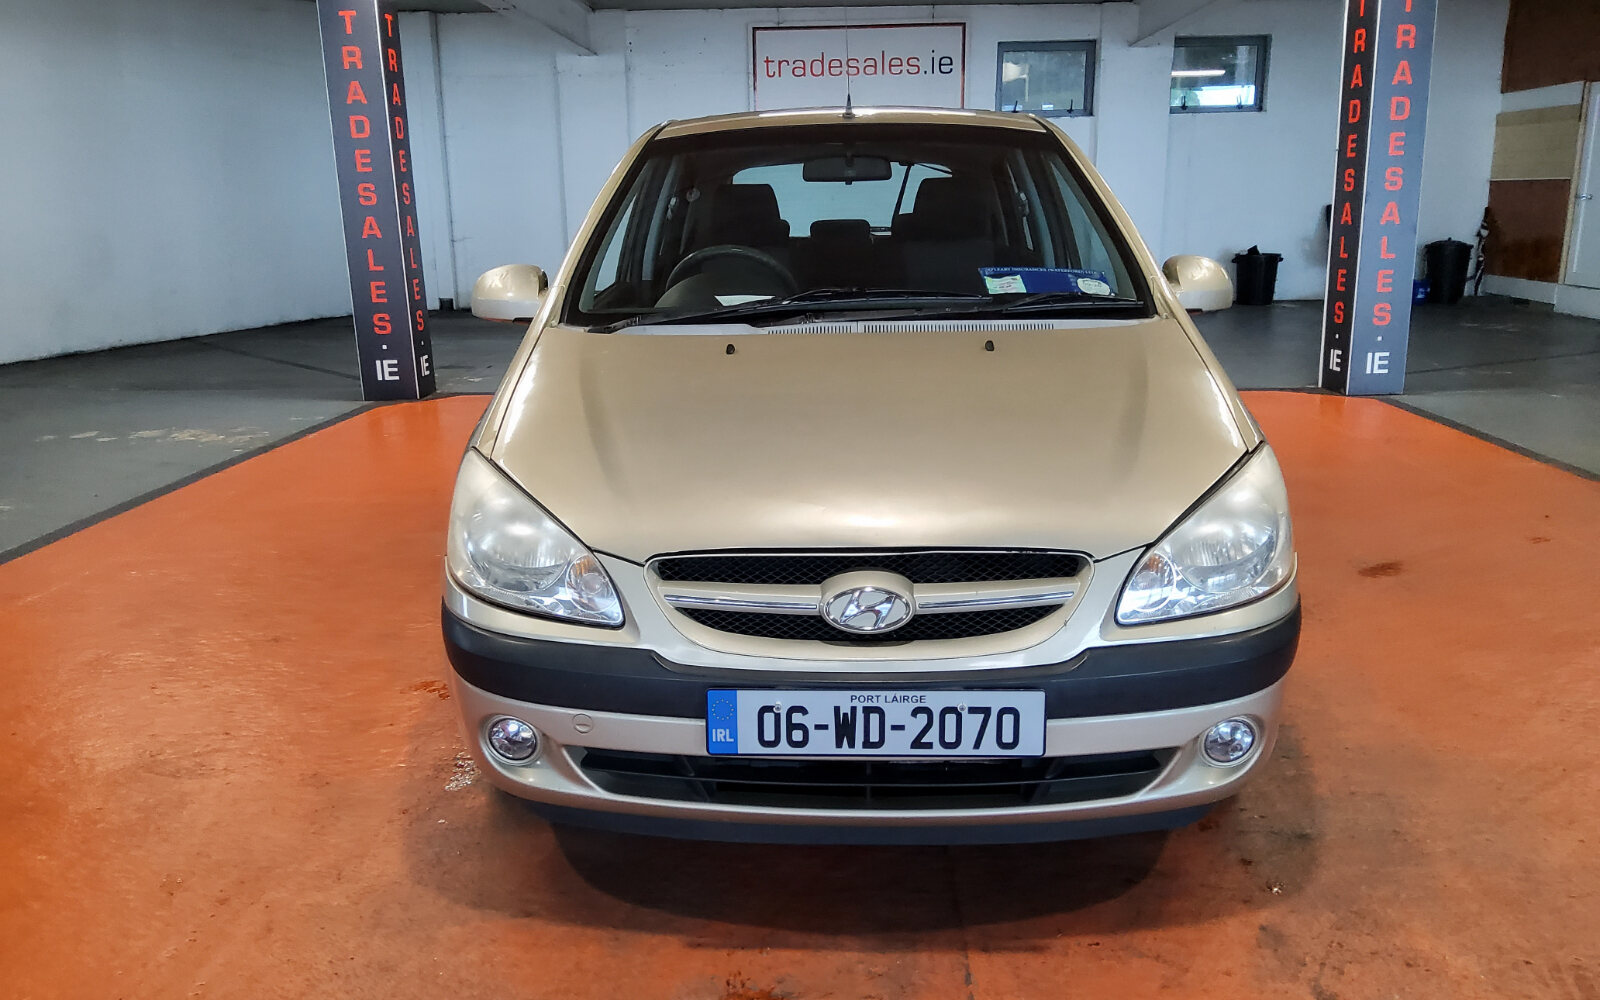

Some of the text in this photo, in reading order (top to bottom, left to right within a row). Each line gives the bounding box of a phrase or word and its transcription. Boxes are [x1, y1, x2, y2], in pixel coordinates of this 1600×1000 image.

[763, 49, 954, 79] tradesales.ie
[850, 693, 927, 704] PORT LÁIRGE
[712, 728, 735, 742] IRL
[757, 704, 1021, 751] 06-WD-2070
